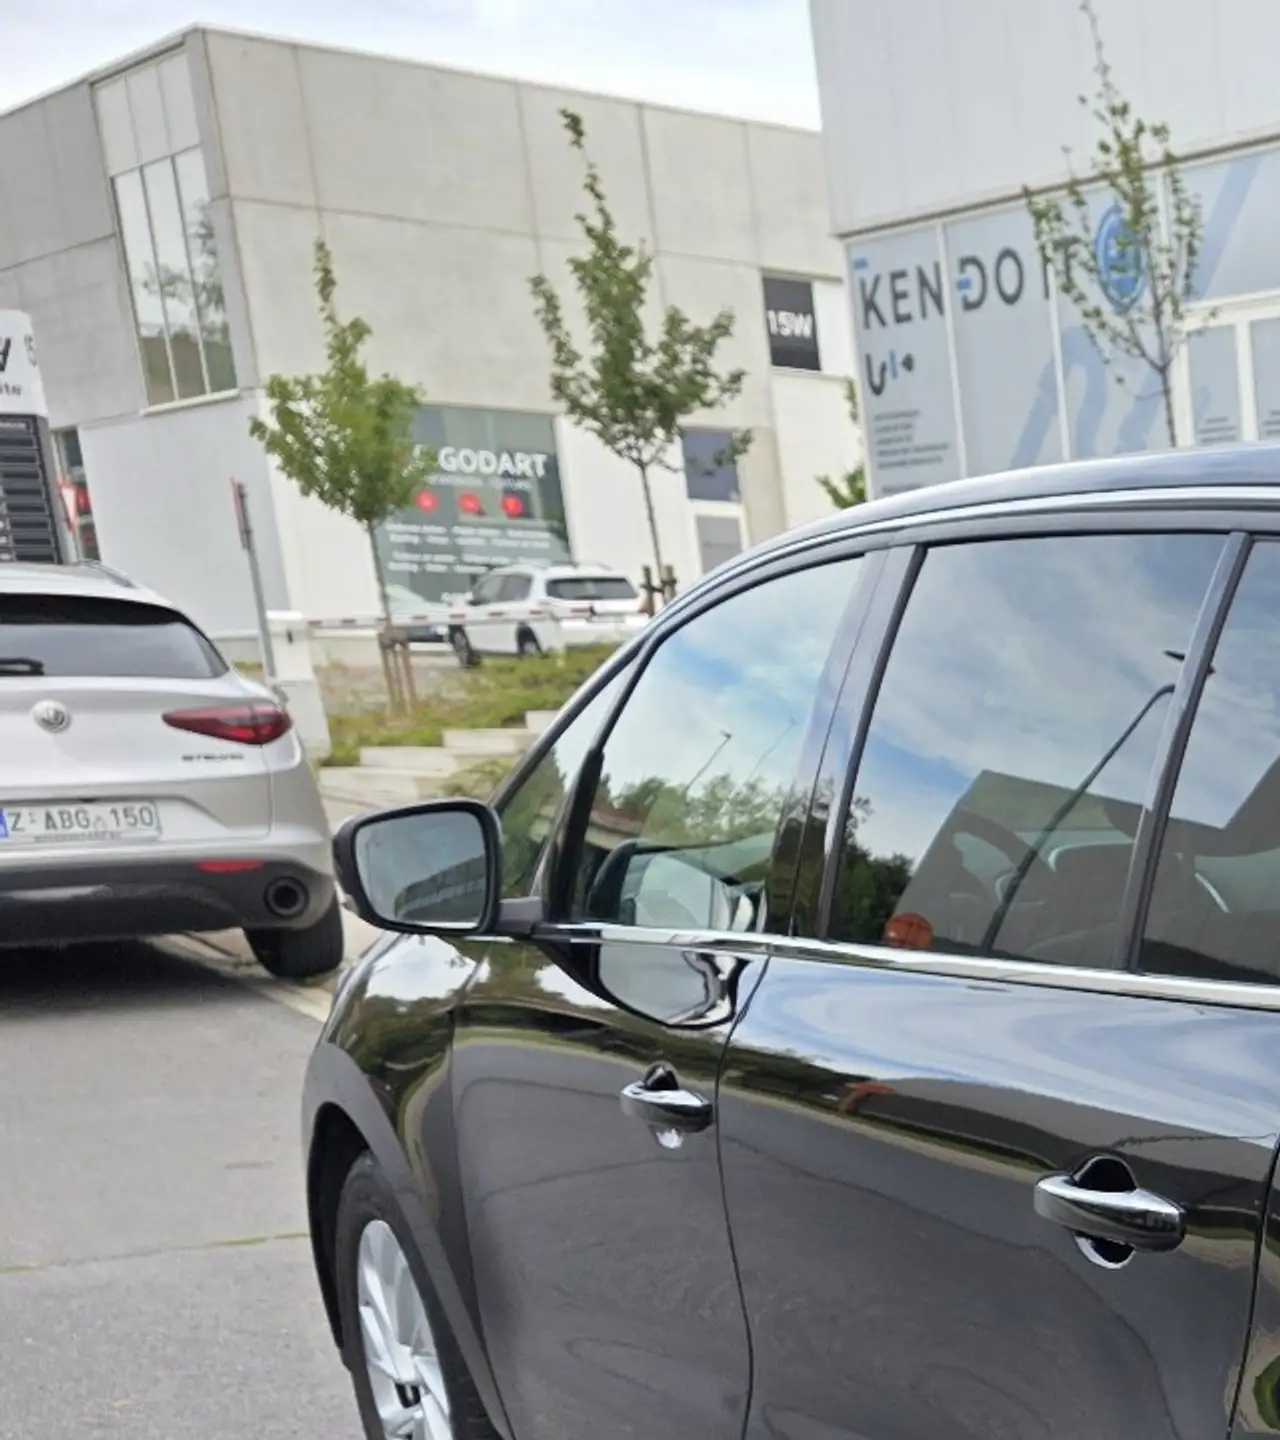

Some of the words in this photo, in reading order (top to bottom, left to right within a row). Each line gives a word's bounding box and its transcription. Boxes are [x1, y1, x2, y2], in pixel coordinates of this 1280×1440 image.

[859, 259, 945, 330] KEN
[766, 310, 813, 338] 15W
[438, 446, 549, 478] GODART
